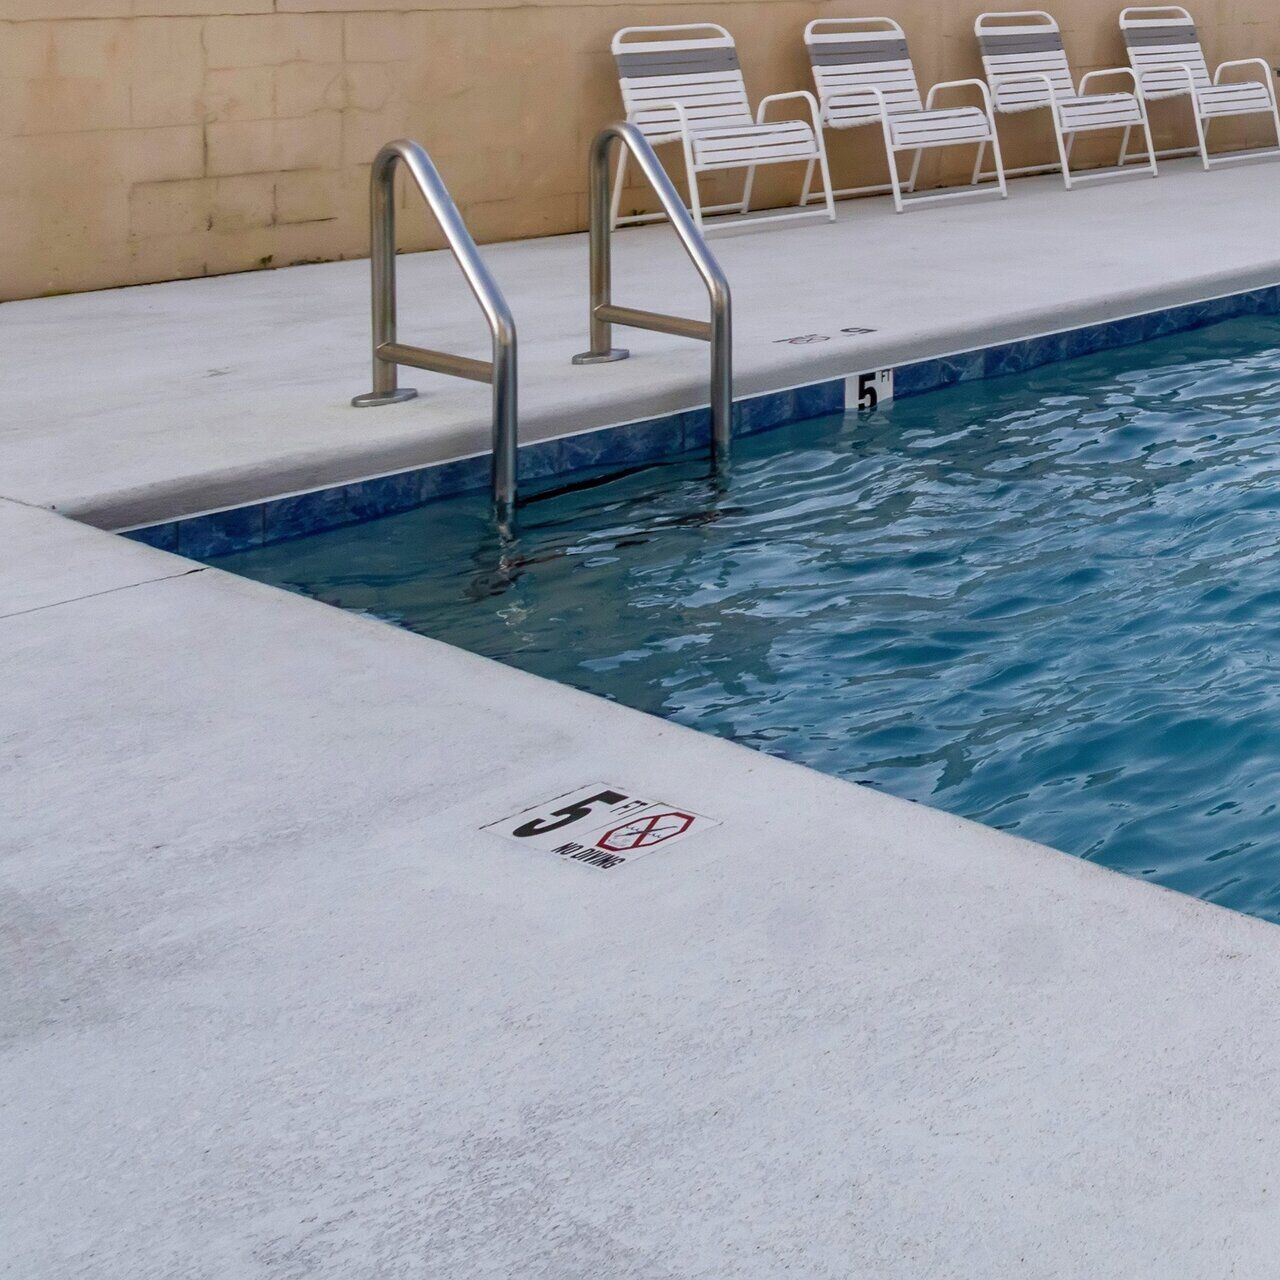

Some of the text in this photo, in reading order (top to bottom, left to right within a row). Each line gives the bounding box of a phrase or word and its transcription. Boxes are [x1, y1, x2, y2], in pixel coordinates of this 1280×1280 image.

[857, 369, 891, 412] 5 FT
[512, 790, 648, 837] 5 FT
[551, 842, 626, 870] NO DIVING
